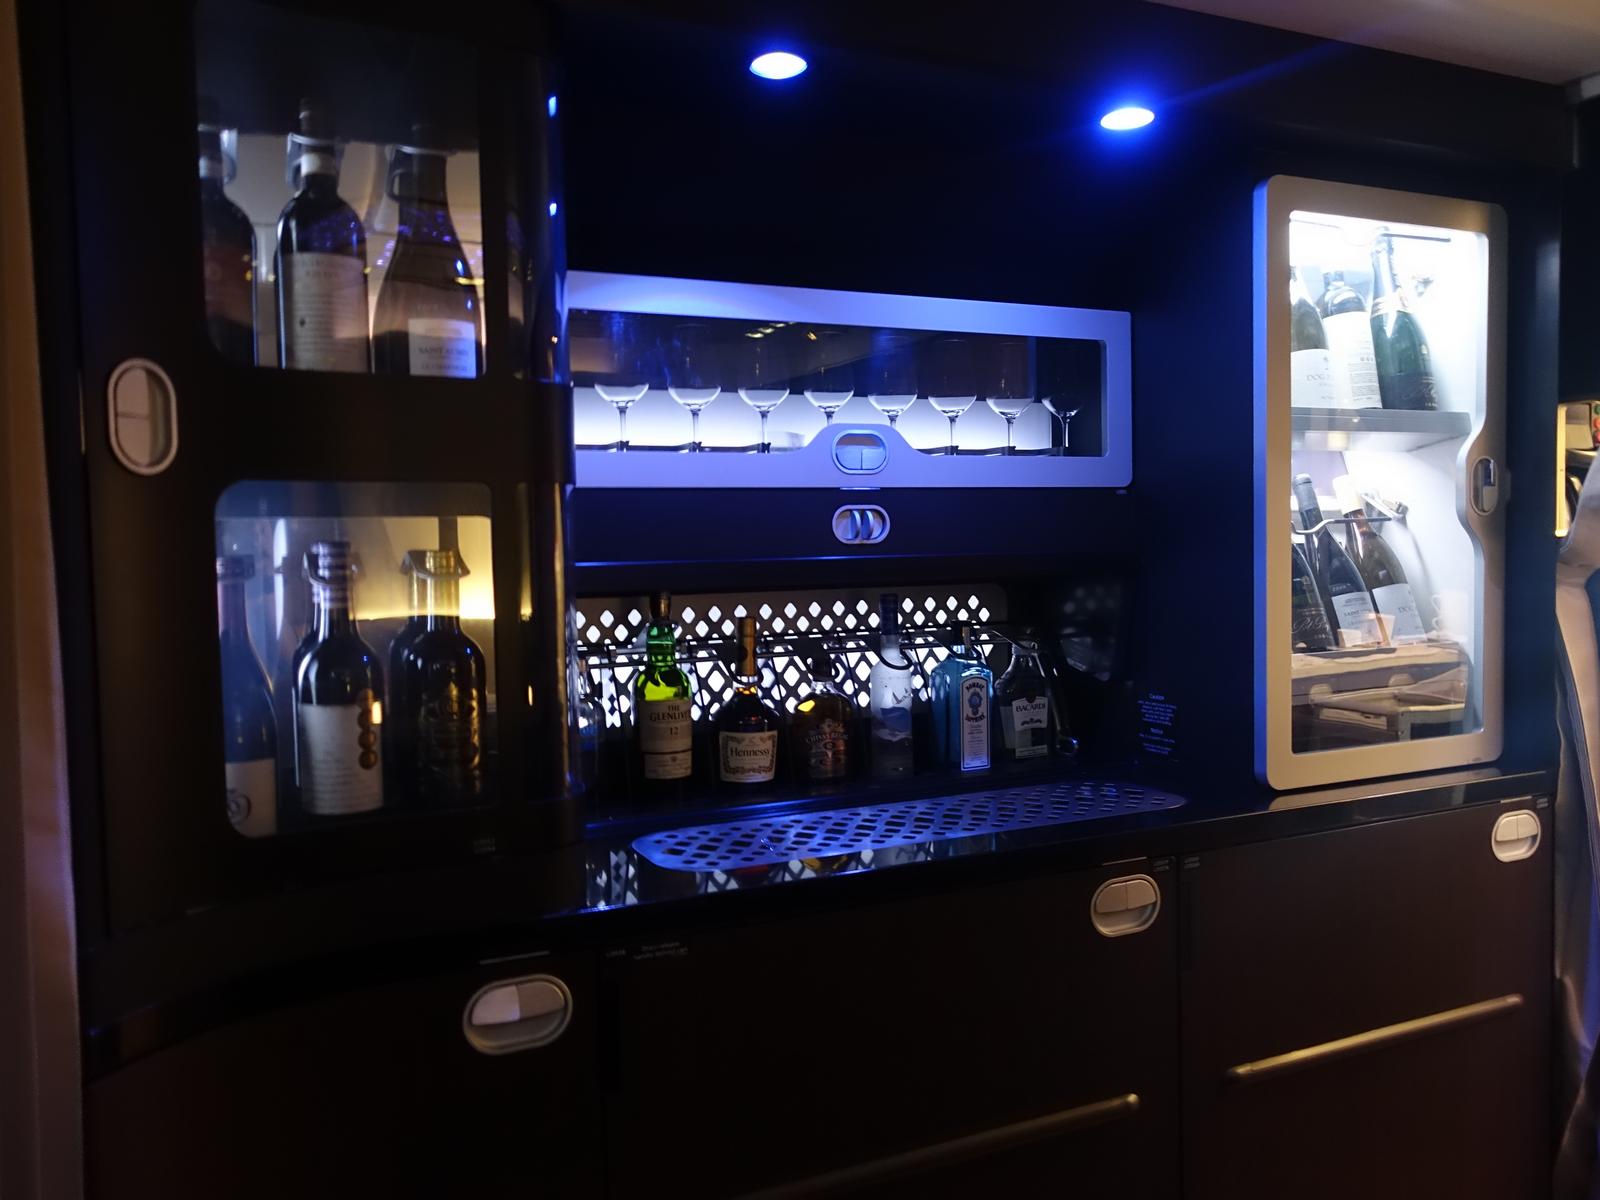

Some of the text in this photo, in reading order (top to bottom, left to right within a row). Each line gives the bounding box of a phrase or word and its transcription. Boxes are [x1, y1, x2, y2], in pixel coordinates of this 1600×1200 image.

[667, 704, 681, 712] THE
[1015, 703, 1046, 713] BACARDI
[669, 726, 679, 736] 12
[729, 746, 770, 759] Hennessy
